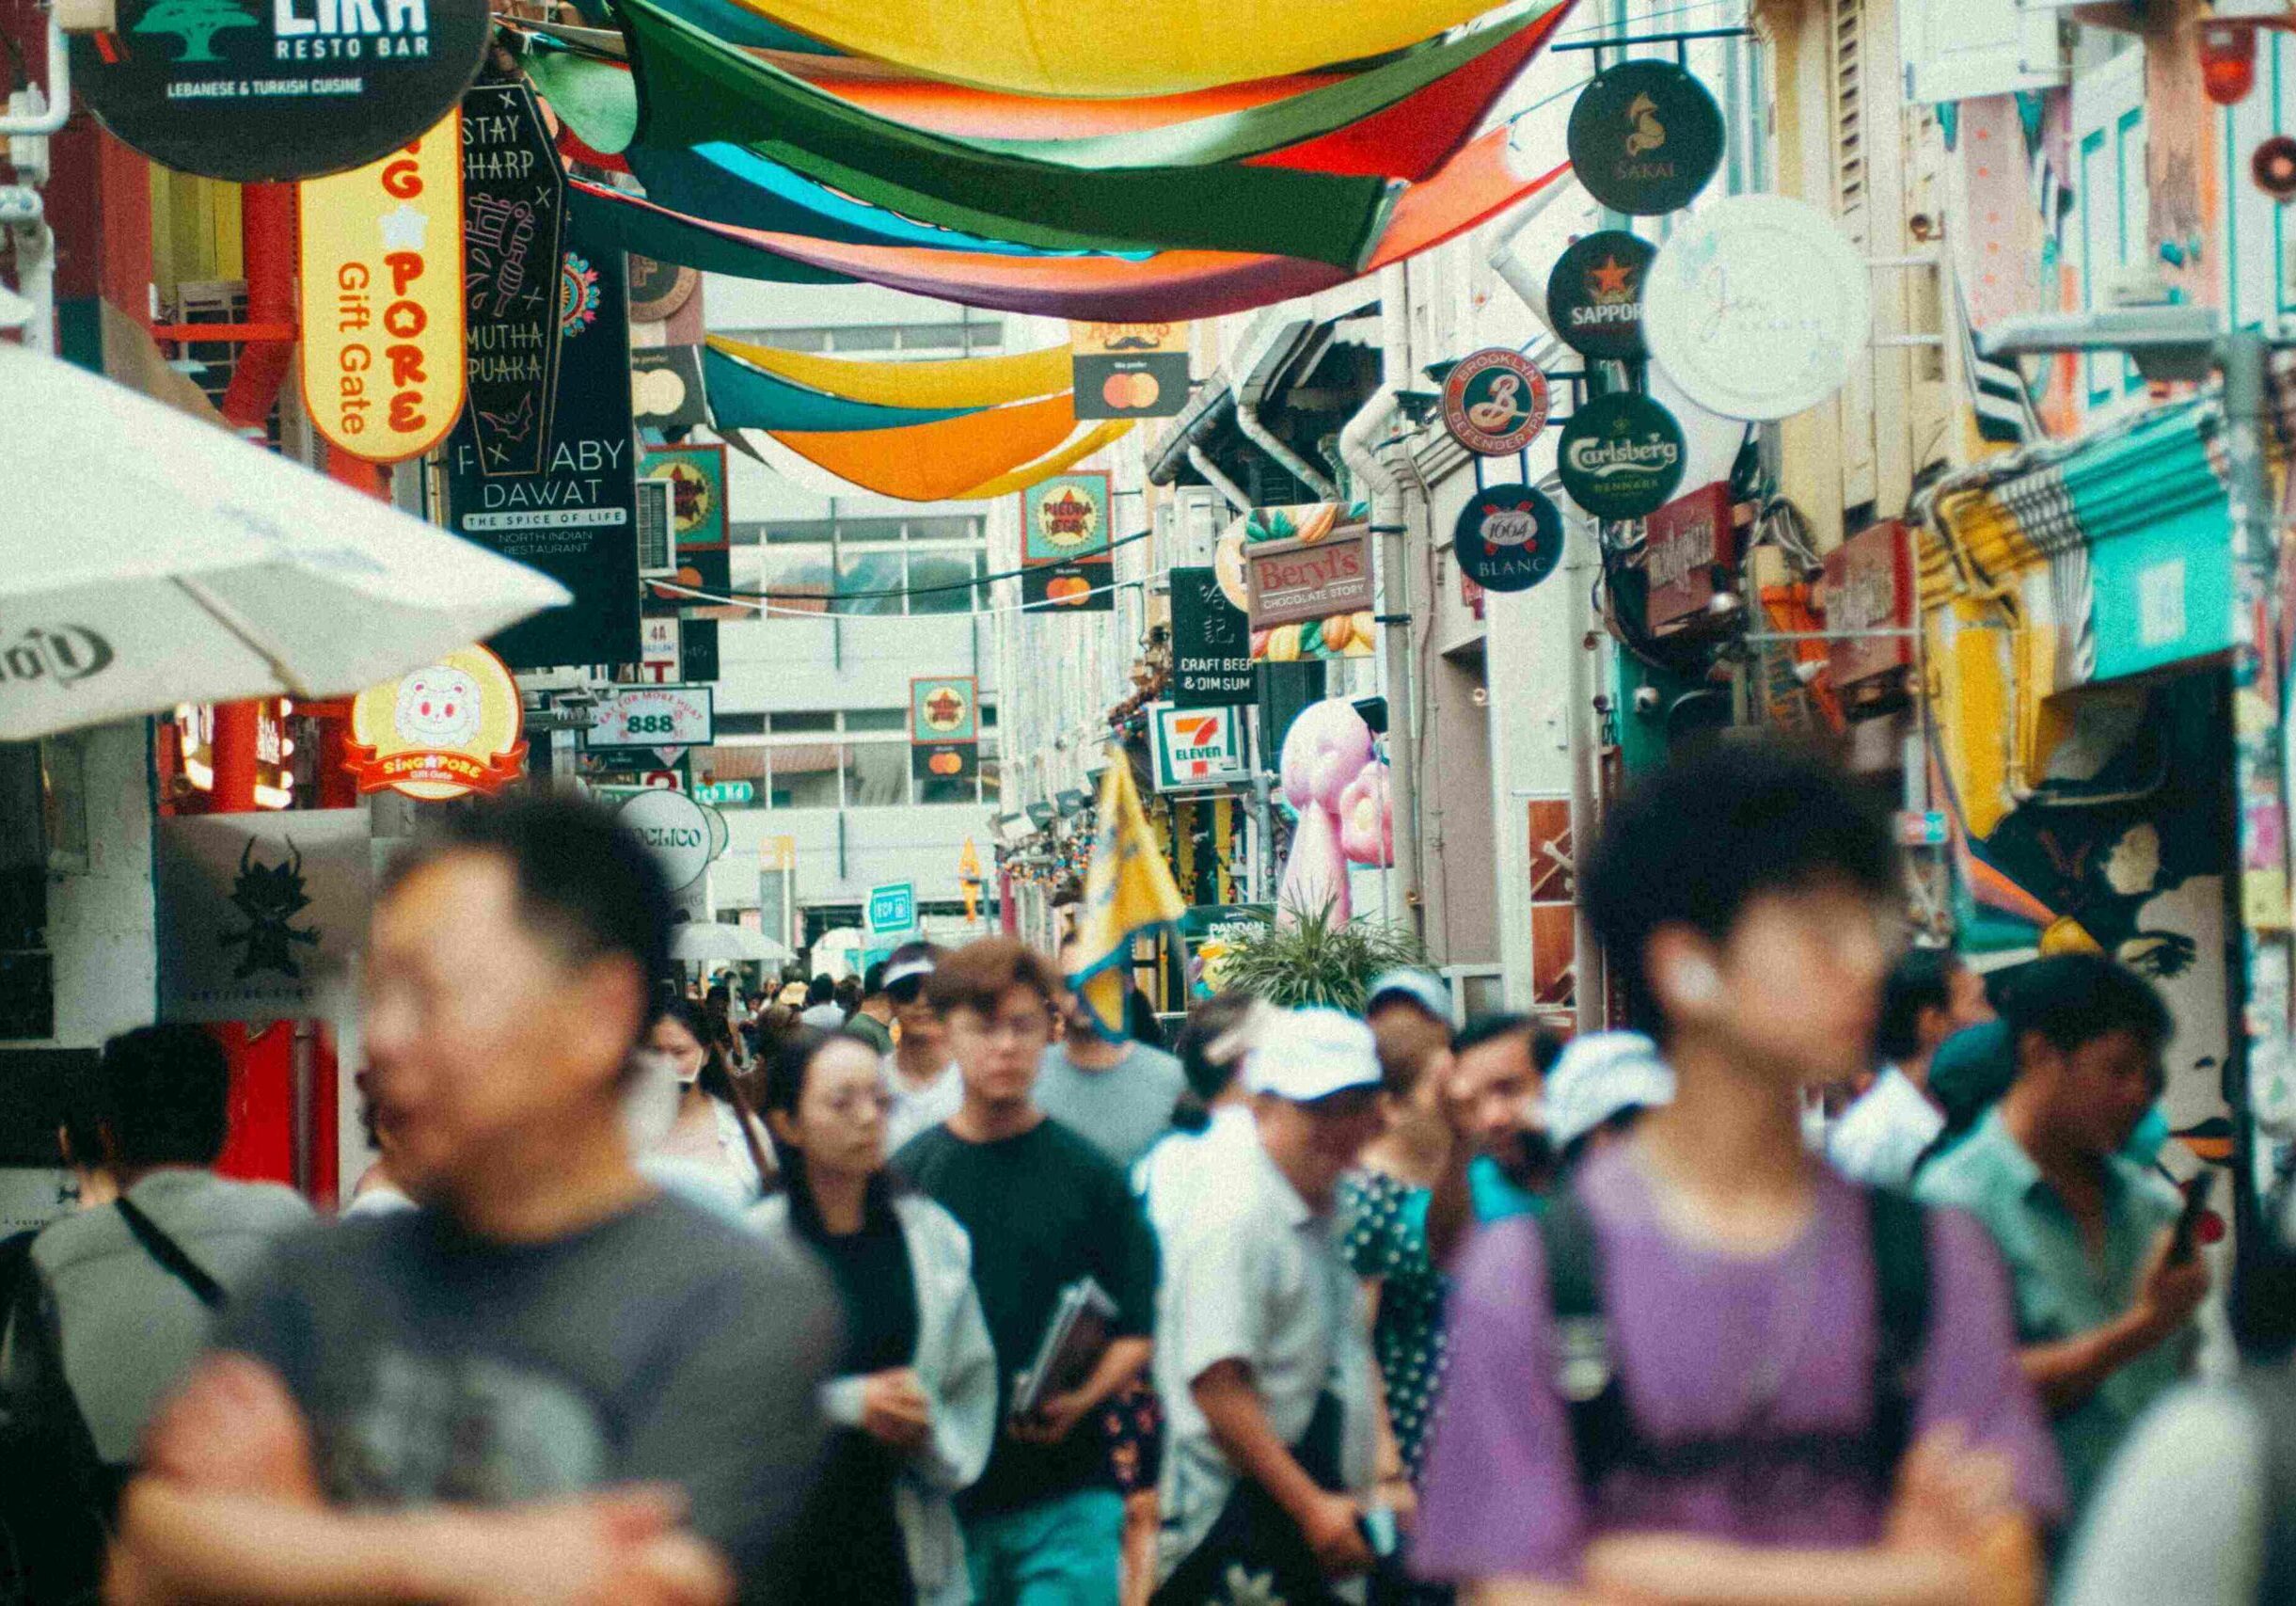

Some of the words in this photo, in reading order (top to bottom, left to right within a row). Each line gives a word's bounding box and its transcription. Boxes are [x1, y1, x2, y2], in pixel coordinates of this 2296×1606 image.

[276, 38, 361, 59] RESTO
[377, 37, 429, 58] BAR
[166, 83, 235, 98] LEBANESE
[239, 83, 249, 96] &
[251, 80, 309, 95] TURKISH
[311, 78, 363, 93] CUISINE
[462, 115, 519, 146] STAY
[462, 151, 535, 181] HARP
[337, 262, 372, 333] Gift
[466, 321, 544, 352] MUTHA
[1458, 353, 1539, 382] BROOKLYN
[339, 343, 372, 435] Gate
[1451, 411, 1526, 450] DEFENDER
[1571, 433, 1678, 472] Carlsberg
[483, 479, 603, 508] DAWAT
[468, 517, 497, 526] THE
[507, 514, 550, 525] SPICE
[560, 512, 578, 523] OF
[588, 511, 622, 522] LIFE
[1489, 520, 1529, 539] 1664
[499, 532, 546, 543] NORTH
[548, 531, 593, 541] INDIAN
[503, 543, 589, 555] RESTAURANT
[1479, 557, 1546, 578] BLANC
[1263, 590, 1327, 610] CHOCOLATE
[1330, 584, 1364, 598] STORY
[1181, 659, 1220, 672] CRAFT
[1223, 658, 1254, 671] BEER
[1184, 676, 1196, 690] &
[1197, 676, 1221, 691] DIM
[1223, 676, 1250, 691] SUM
[627, 715, 674, 734] 888
